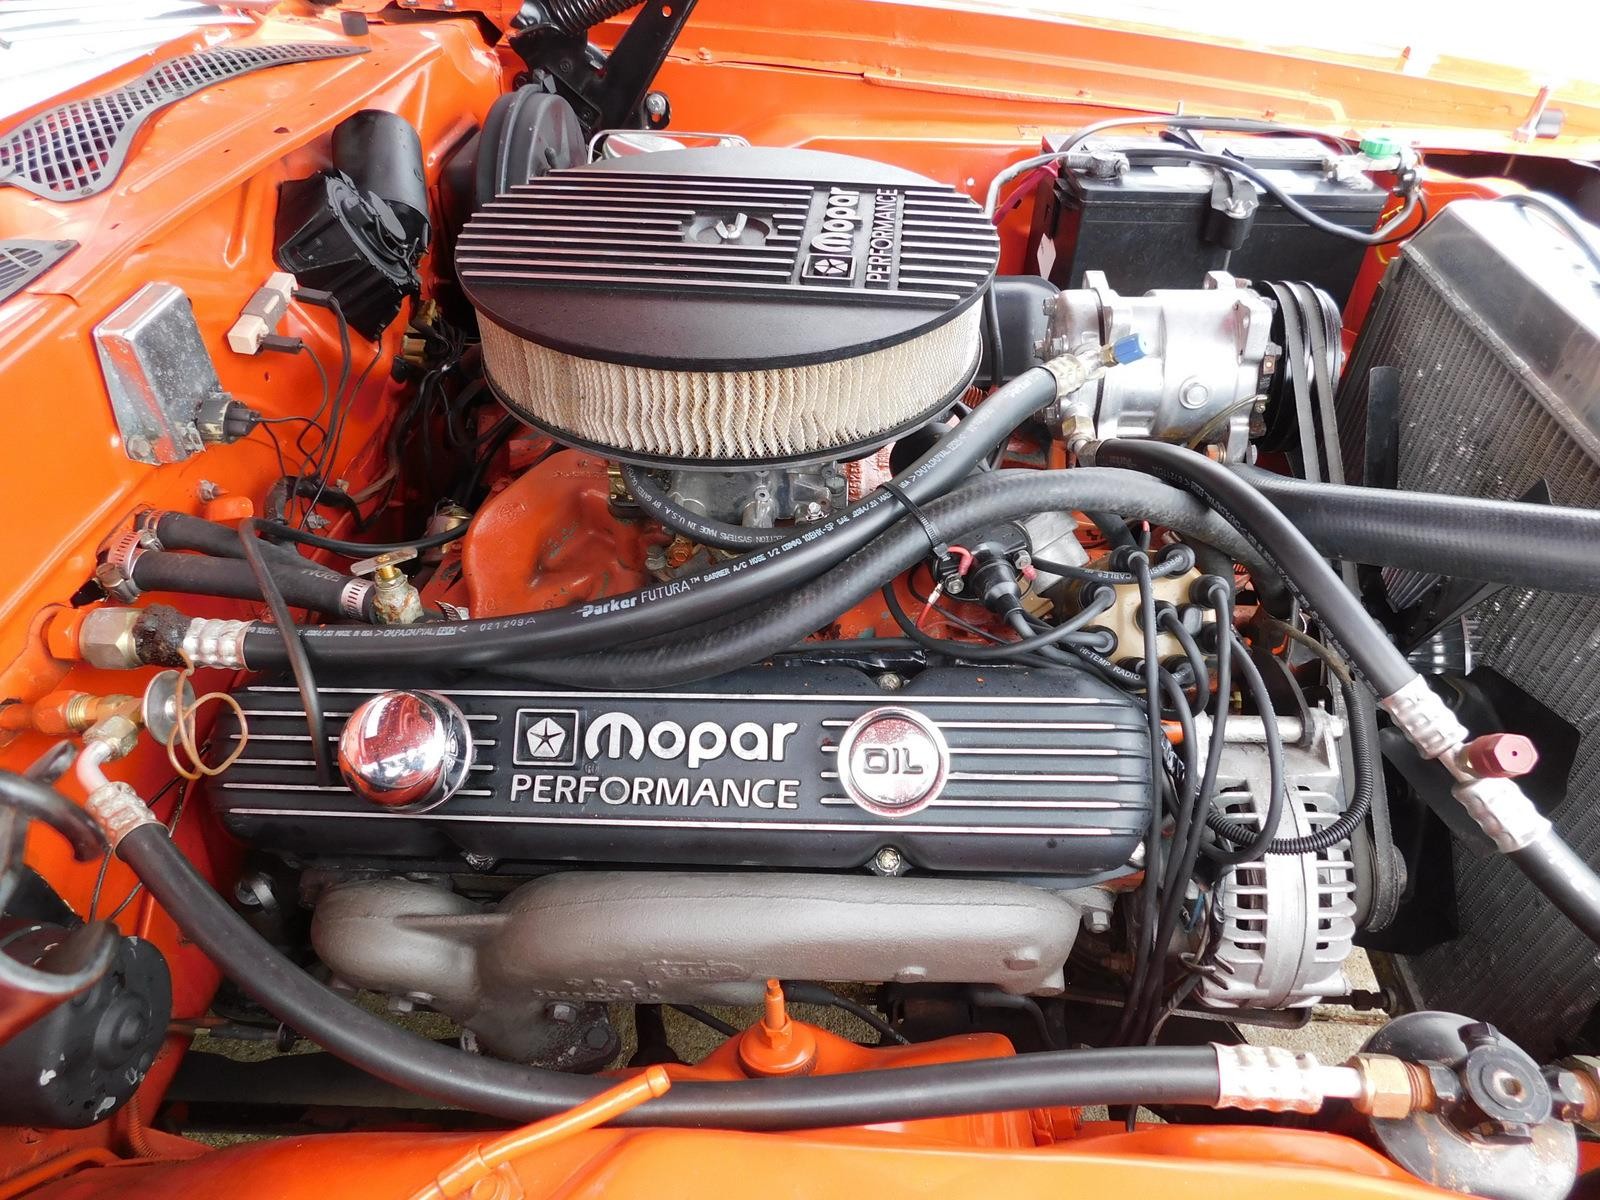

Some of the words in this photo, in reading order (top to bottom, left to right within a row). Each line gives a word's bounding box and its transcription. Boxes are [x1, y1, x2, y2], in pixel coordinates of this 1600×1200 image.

[811, 186, 863, 252] Mopar
[866, 188, 898, 282] PERFORMANCE
[636, 485, 652, 502] GATES
[652, 500, 662, 510] BY
[664, 506, 685, 525] U.S.A.
[687, 520, 697, 530] IN
[699, 526, 718, 538] MADE
[719, 532, 752, 543] SYSTEMS
[572, 595, 638, 618] Parker
[703, 567, 730, 582] BARRIER
[733, 561, 748, 573] A/C
[749, 552, 767, 566] HOSE
[768, 546, 781, 558] 1/2
[836, 515, 850, 526] SAE
[1080, 646, 1111, 667] HI-TEMP
[1113, 665, 1141, 680] RADIO
[584, 711, 798, 768] Mopar
[863, 747, 923, 774] OIL
[511, 774, 800, 809] PERFORMANCE
